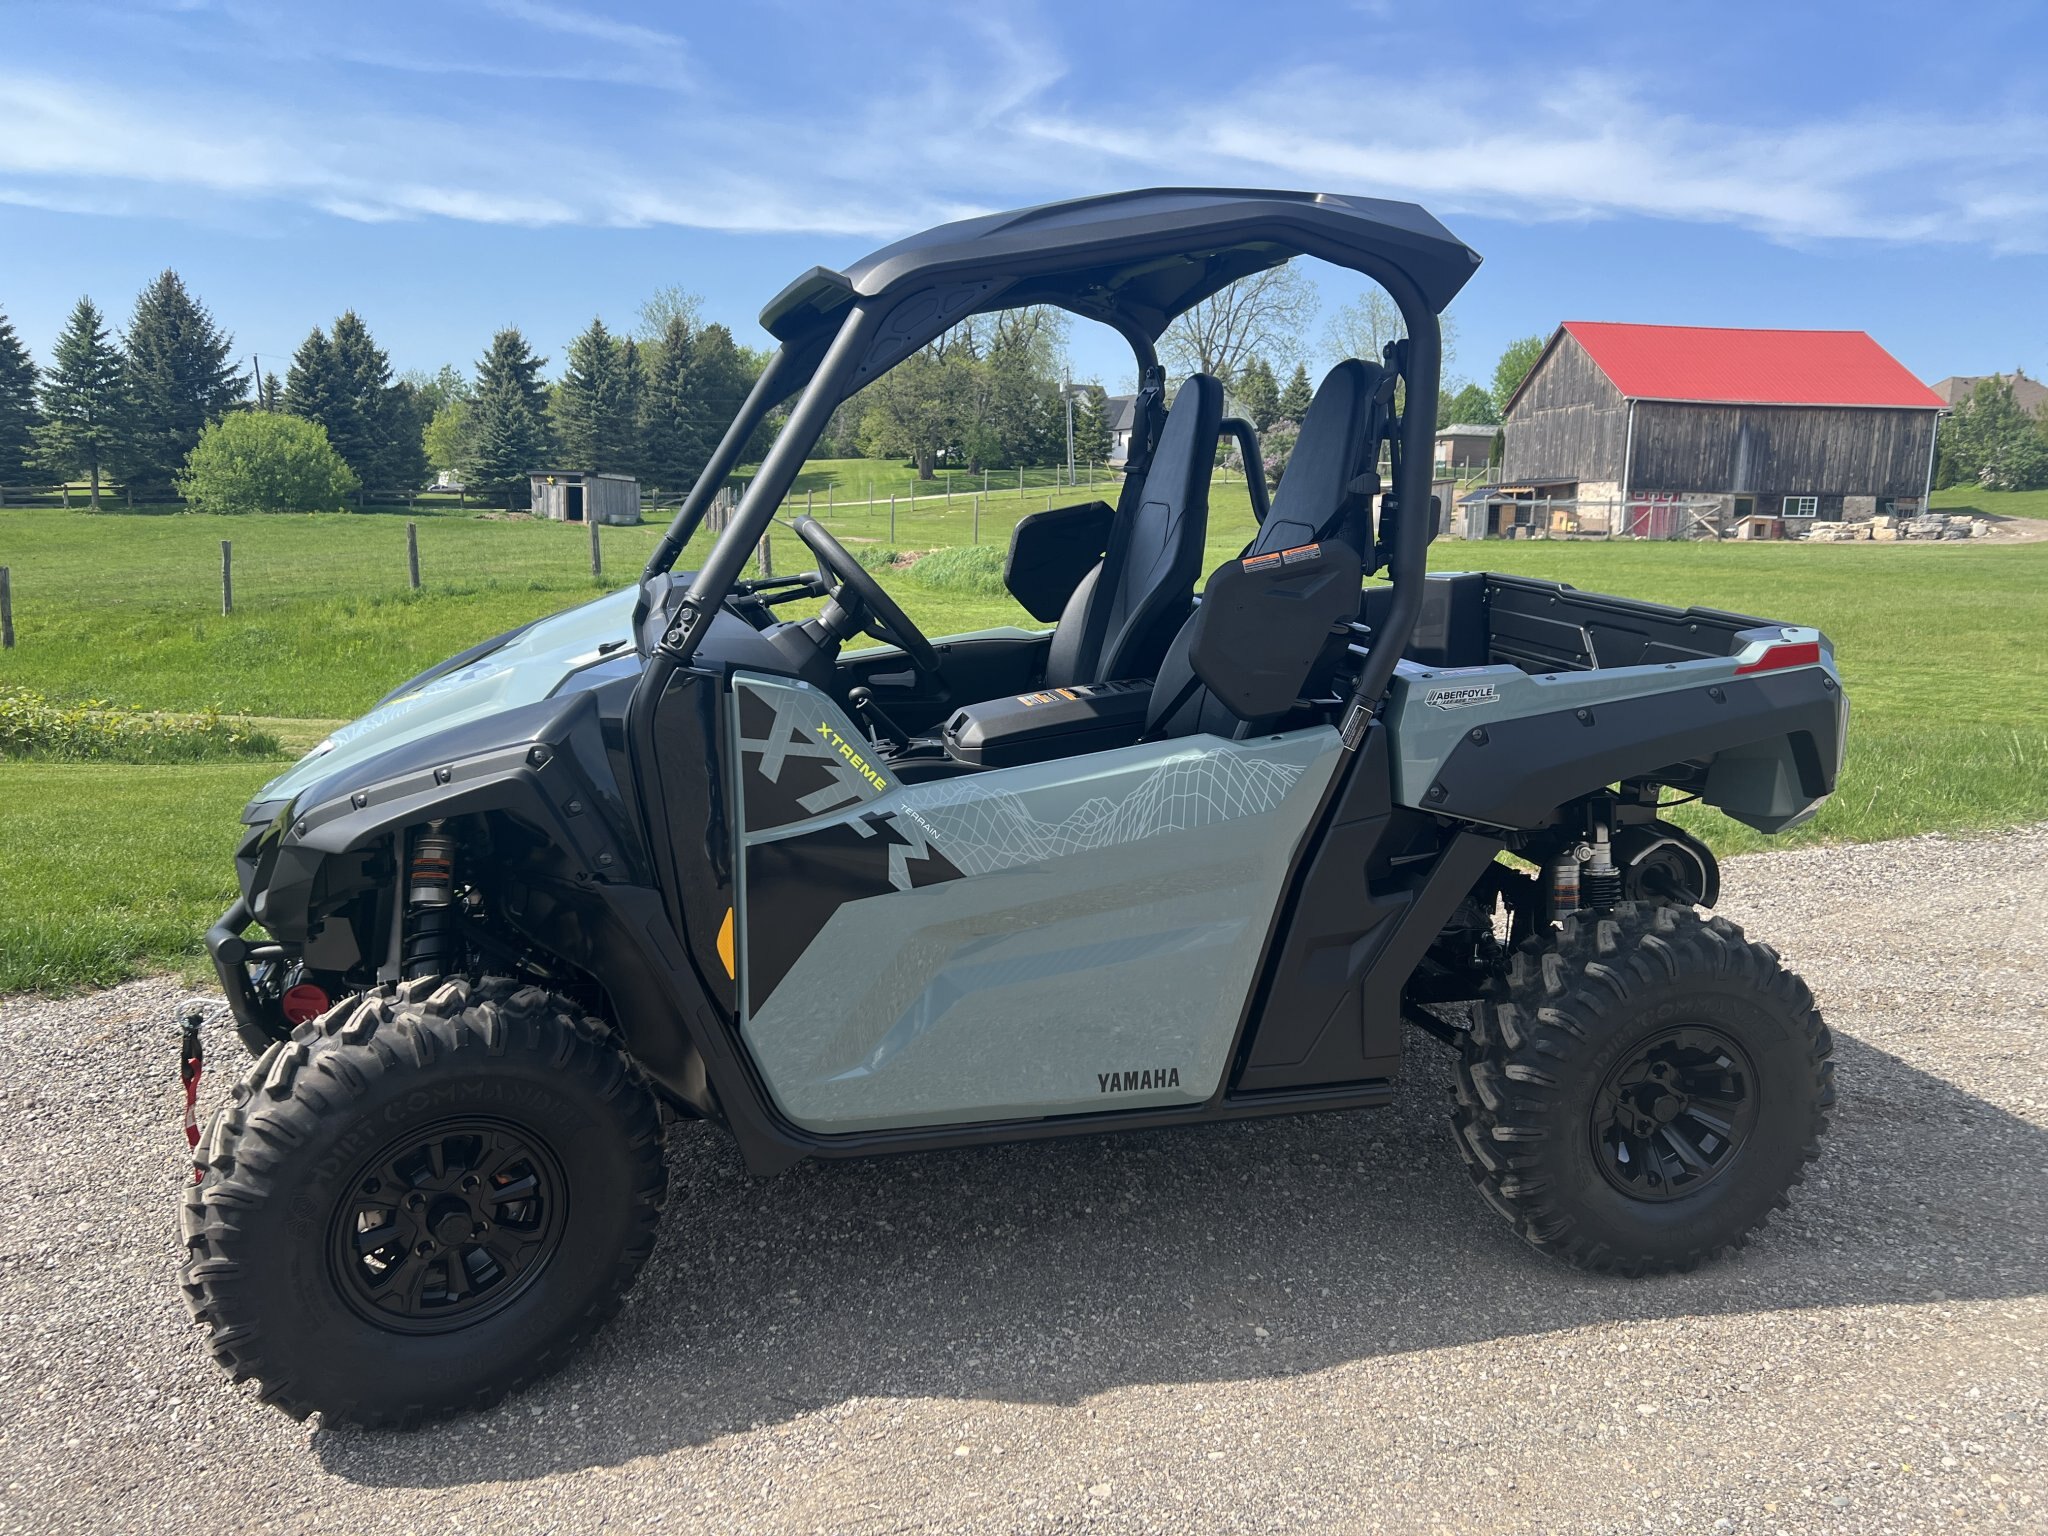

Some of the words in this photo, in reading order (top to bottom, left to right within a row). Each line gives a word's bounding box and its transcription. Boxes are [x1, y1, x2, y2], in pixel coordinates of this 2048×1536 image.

[1436, 688, 1493, 700] ABERFOYLE
[816, 721, 887, 792] XTREME
[900, 803, 941, 840] TERRAIN
[1097, 1067, 1180, 1093] YAMAHA
